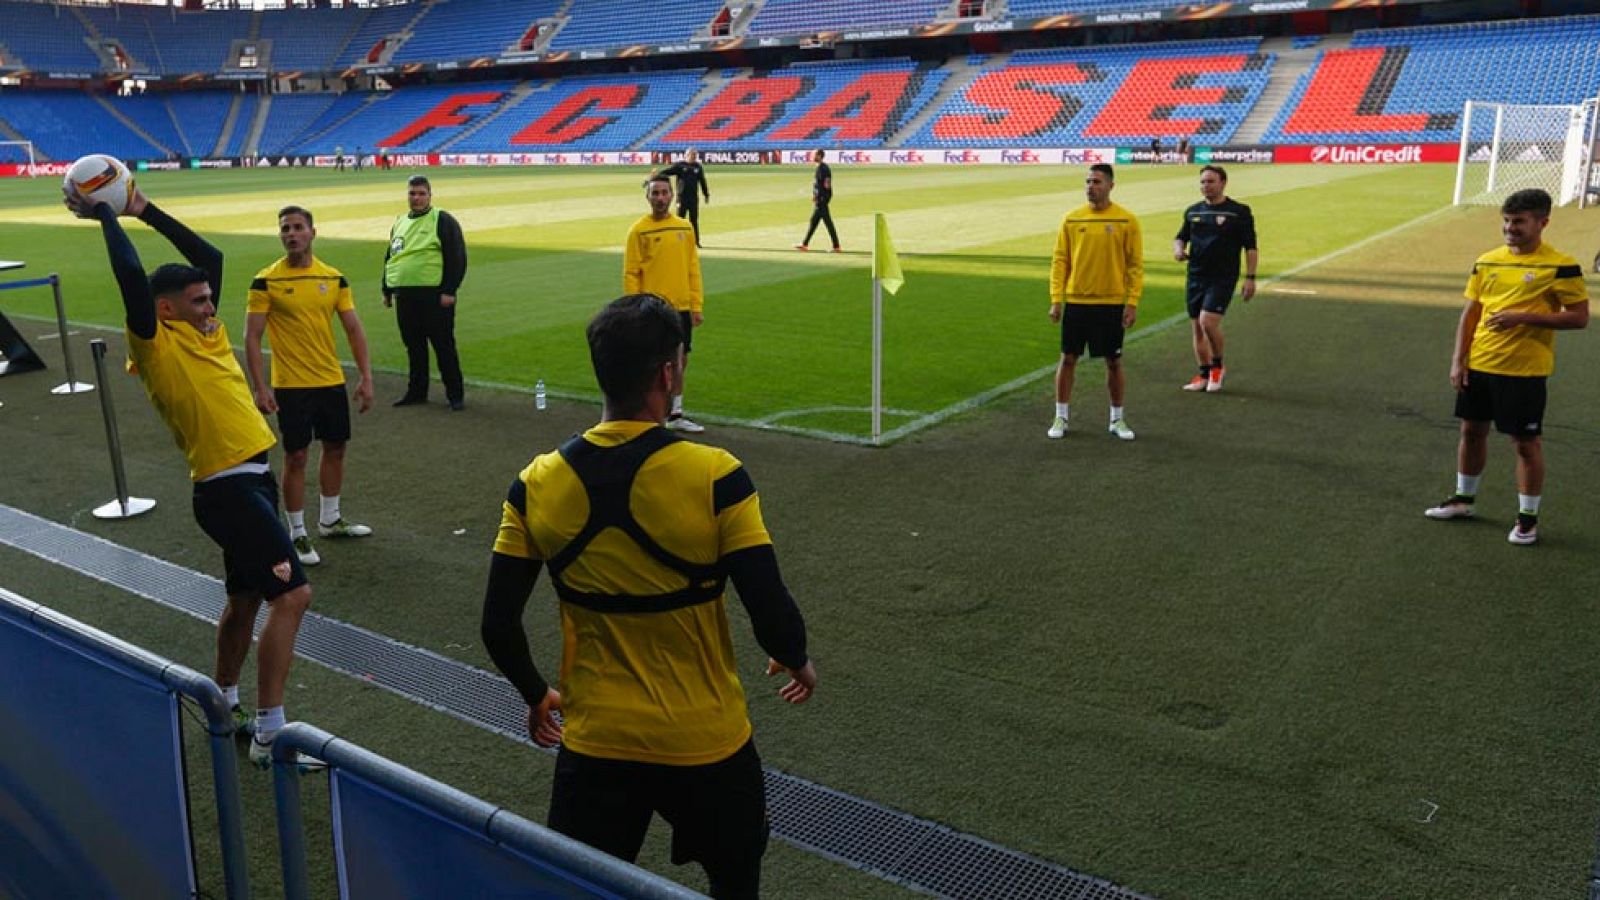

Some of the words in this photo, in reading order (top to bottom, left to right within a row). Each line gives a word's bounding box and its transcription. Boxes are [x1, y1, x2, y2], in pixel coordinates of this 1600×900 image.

[374, 84, 642, 147] FC
[660, 47, 1440, 142] BASEL
[704, 151, 734, 163] FINAL
[839, 151, 873, 163] FedEx
[889, 151, 924, 163] FedEx
[944, 151, 980, 163] FedEx
[1001, 150, 1040, 163] FedEx
[1062, 150, 1102, 163] FedEx
[1196, 149, 1273, 162] enterprise
[1331, 146, 1422, 162] UniCredit
